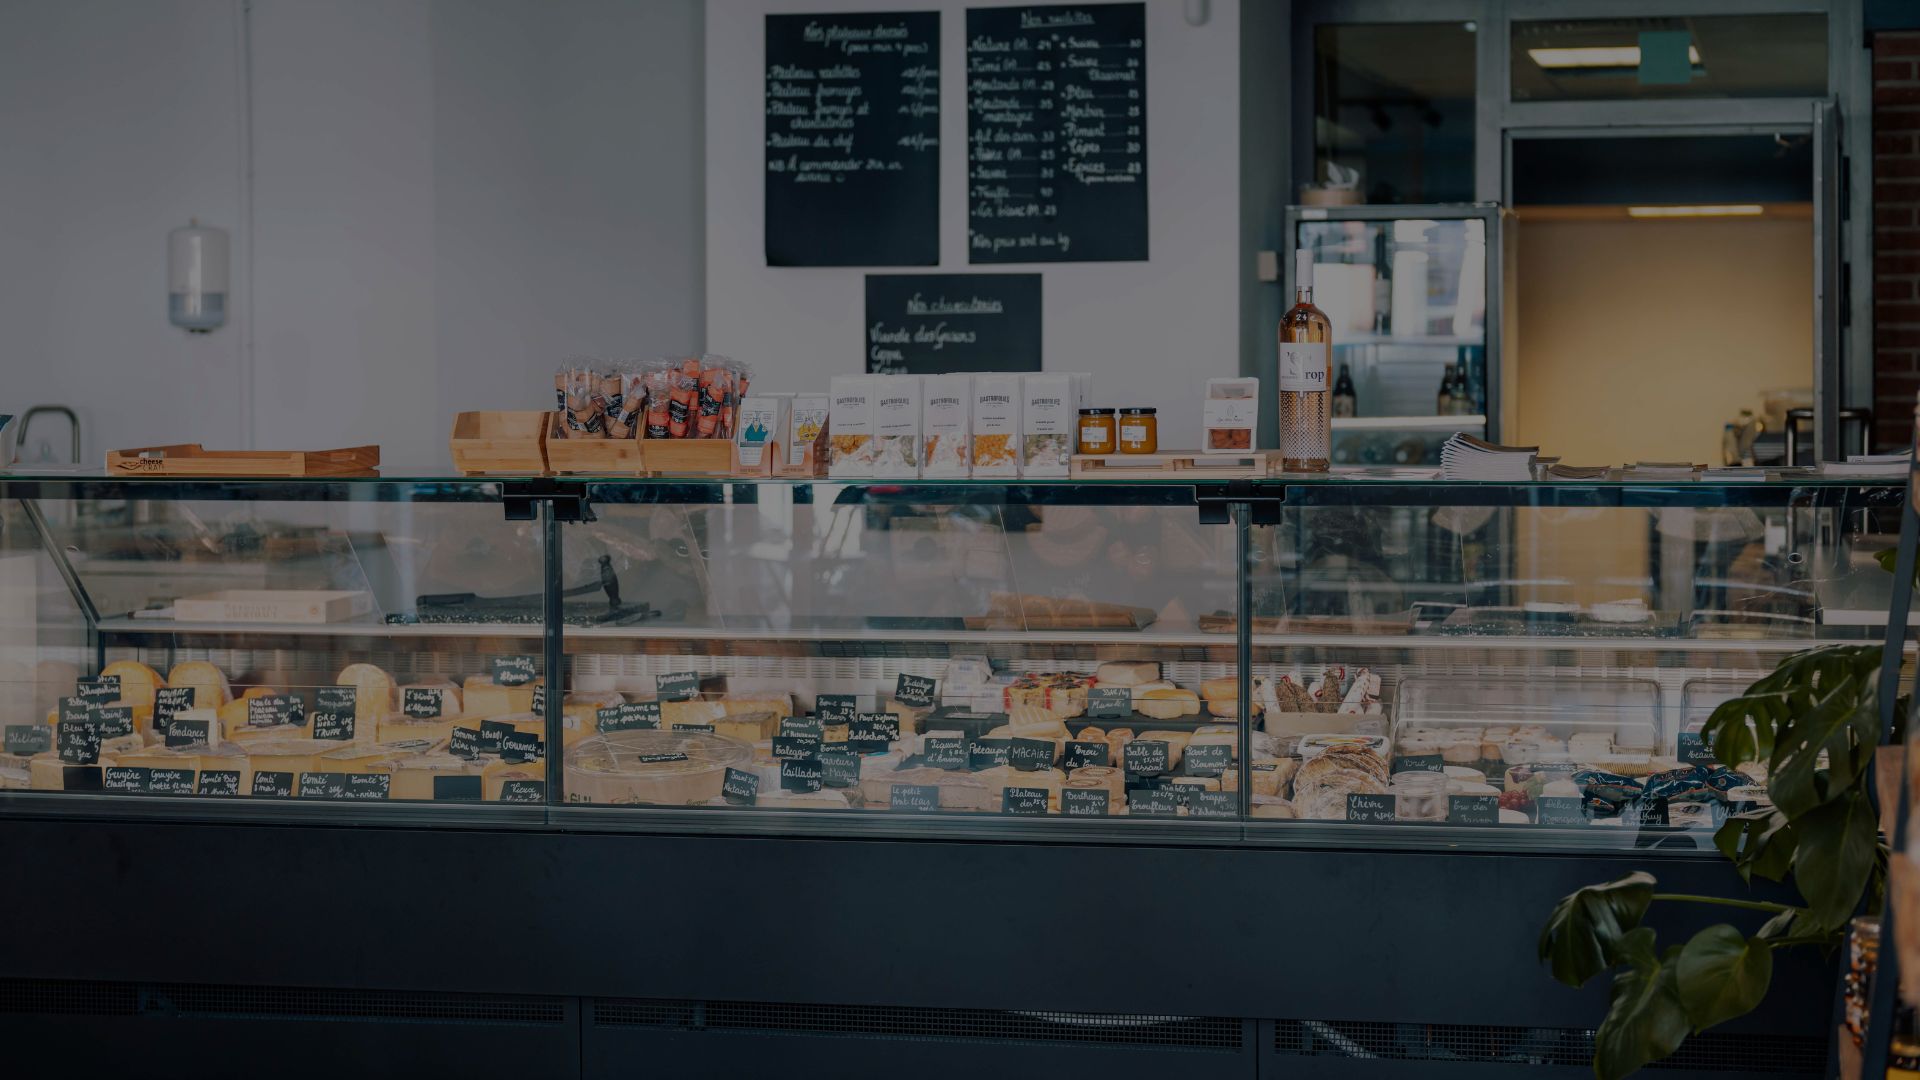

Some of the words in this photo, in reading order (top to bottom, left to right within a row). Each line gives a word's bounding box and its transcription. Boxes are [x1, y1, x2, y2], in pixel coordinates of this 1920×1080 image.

[62, 722, 85, 734] Bleu
[1152, 745, 1164, 756] de
[1211, 745, 1224, 756] de
